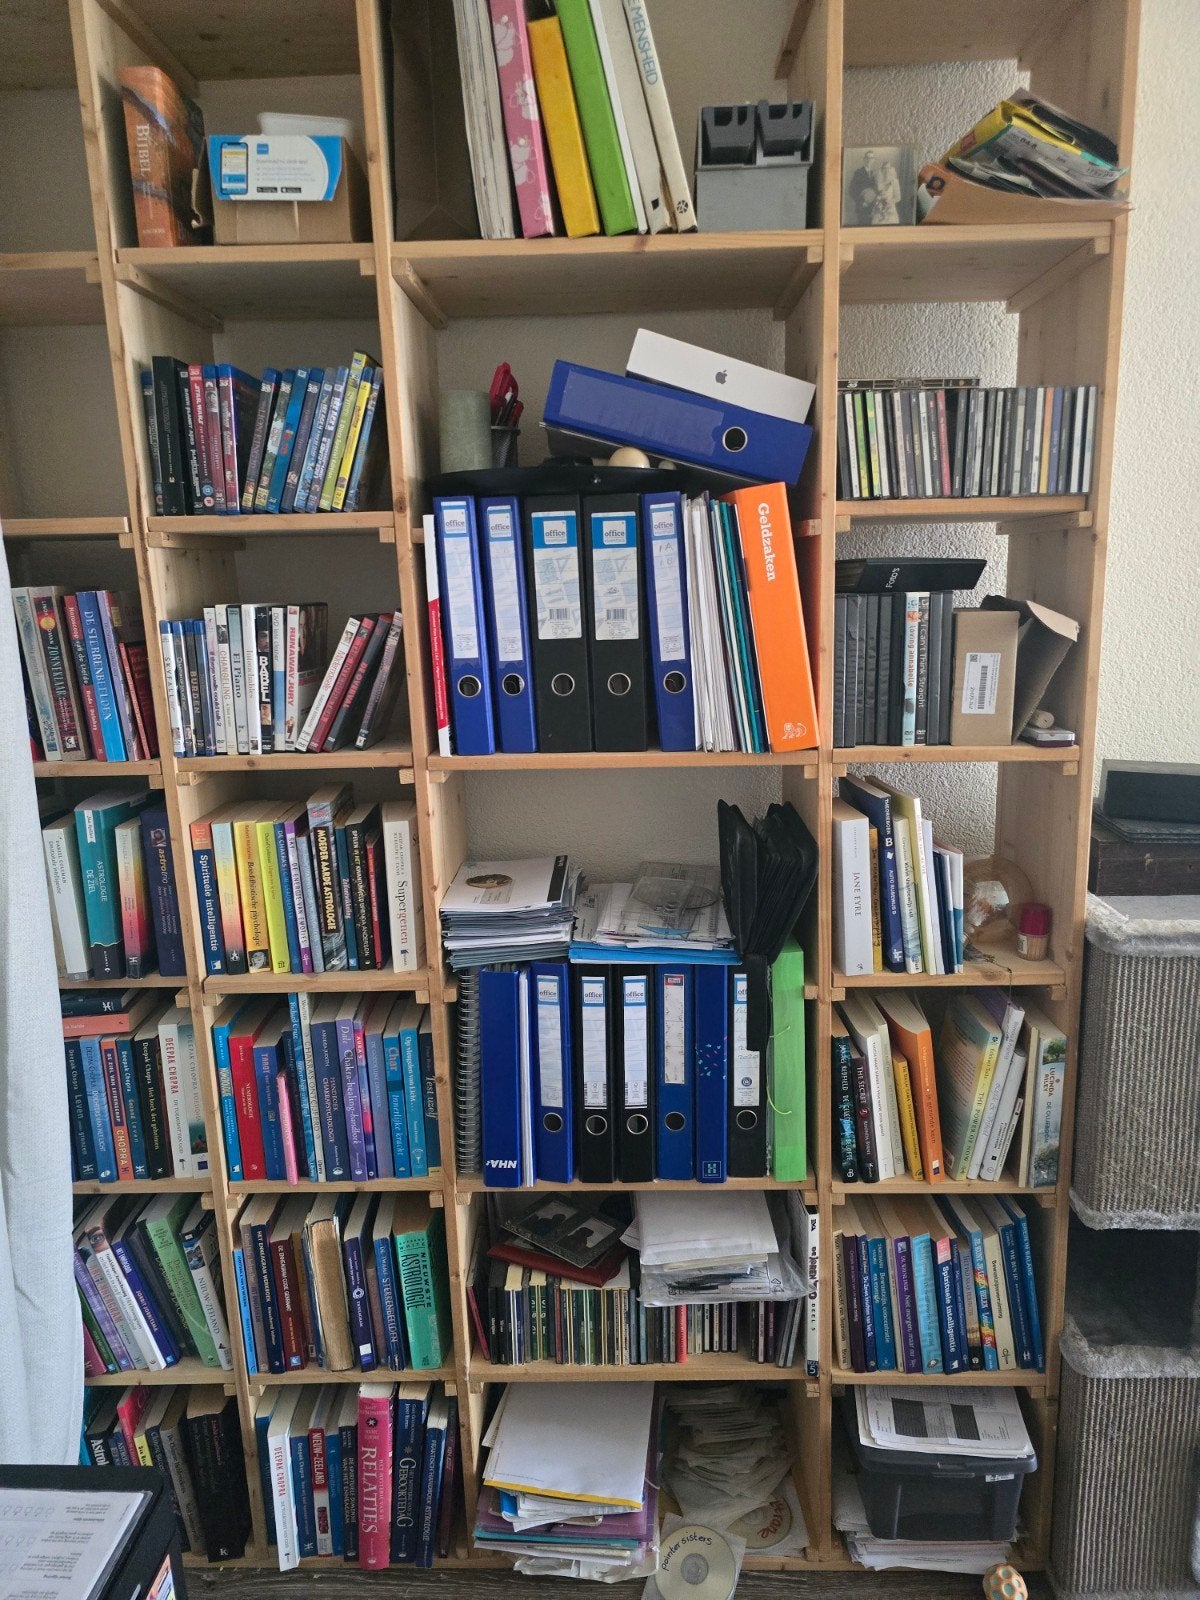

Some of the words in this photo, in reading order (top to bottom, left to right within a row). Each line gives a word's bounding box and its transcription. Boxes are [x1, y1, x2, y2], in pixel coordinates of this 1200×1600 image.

[631, 6, 658, 85] MENSHEID
[194, 382, 202, 404] STAR
[445, 519, 465, 528] office
[491, 523, 510, 531] office
[545, 529, 566, 537] office
[604, 529, 625, 537] office
[654, 520, 674, 529] office
[757, 502, 776, 582] Geldzaken
[83, 609, 95, 625] DE
[67, 606, 80, 639] Horoscoop
[78, 652, 84, 661] de
[919, 628, 927, 650] Can't
[46, 644, 66, 696] ZONNEKLAAR
[232, 652, 240, 663] El
[357, 660, 368, 673] DE
[907, 650, 915, 687] annabelle
[919, 653, 927, 674] Think
[87, 626, 112, 721] STERRENBEELDEN
[164, 656, 175, 699] SKYFALL
[219, 649, 231, 700] CHANGELING
[233, 666, 243, 698] Piano
[245, 649, 256, 698] Intouchables
[258, 654, 270, 702] BABEL
[189, 670, 201, 714] BURDEN
[212, 691, 220, 709] could
[341, 672, 363, 710] OVERVAL
[916, 677, 926, 708] Straight
[316, 828, 328, 860] MOEDER
[351, 830, 359, 848] SPELEN
[85, 868, 94, 878] DE
[86, 879, 95, 894] ZIEL
[96, 859, 108, 902] ASTROLOGIE
[198, 854, 213, 897] Spirituele
[246, 860, 258, 908] Boeddhistische
[320, 860, 331, 886] AARDE
[851, 871, 860, 893] JANE
[323, 886, 336, 929] ASTROLOGIE
[394, 880, 410, 944] Supergenen
[853, 895, 861, 916] EYRE
[204, 898, 220, 951] intelligentie
[249, 909, 262, 947] psychologie
[186, 1033, 195, 1059] DEEPAK
[340, 1025, 350, 1043] Dale
[404, 1035, 412, 1046] Op
[67, 1048, 76, 1069] Deepak
[121, 1050, 129, 1071] Deepak
[142, 1041, 150, 1062] Deepak
[164, 1036, 175, 1064] DEEPAK
[260, 1053, 269, 1074] TAROT
[387, 1046, 400, 1071] Char
[70, 1070, 79, 1090] Chopra
[124, 1071, 132, 1092] Chopra
[144, 1063, 152, 1084] Chopra
[168, 1065, 179, 1094] CHOPRA
[189, 1061, 198, 1089] CHOPRA
[425, 1075, 436, 1094] Test
[856, 1065, 864, 1079] THE
[340, 1048, 361, 1145] Chakra-healing-handboek
[857, 1080, 867, 1103] SECRET
[976, 1091, 984, 1105] THE
[1045, 1101, 1051, 1109] DE
[74, 1093, 85, 1119] Leven
[321, 1076, 335, 1143] CHAKRAPSYCHOLOGIE
[390, 1093, 403, 1131] Innerlijke
[423, 1096, 438, 1120] uzelf
[970, 1108, 980, 1133] POWER
[115, 1129, 128, 1165] CHOPRA
[395, 1132, 405, 1155] kracht
[963, 1144, 972, 1162] NOW
[258, 1241, 267, 1274] ENNEAGRAM
[400, 1252, 425, 1310] ASTROLOGIE
[420, 1251, 432, 1308] NIEUWSTE
[941, 1265, 952, 1304] Spirituele
[197, 1276, 220, 1335] NIEUW-ZEELAND
[381, 1276, 398, 1343] STERRENBEELDEN
[979, 1289, 988, 1308] HELEN
[944, 1305, 957, 1352] intelligentie
[88, 1436, 110, 1467] Astrol
[272, 1446, 284, 1470] DEEPAK
[311, 1432, 325, 1485] NIEUW-ZEELAND
[428, 1439, 437, 1470] PRAKTISCH
[276, 1471, 286, 1497] CHOPRA
[360, 1446, 378, 1534] RELATIES
[425, 1471, 434, 1504] HANDBOEK
[422, 1504, 432, 1541] ASTROLOGIE
[661, 1541, 681, 1572] pointer
[681, 1531, 713, 1546] sisters
